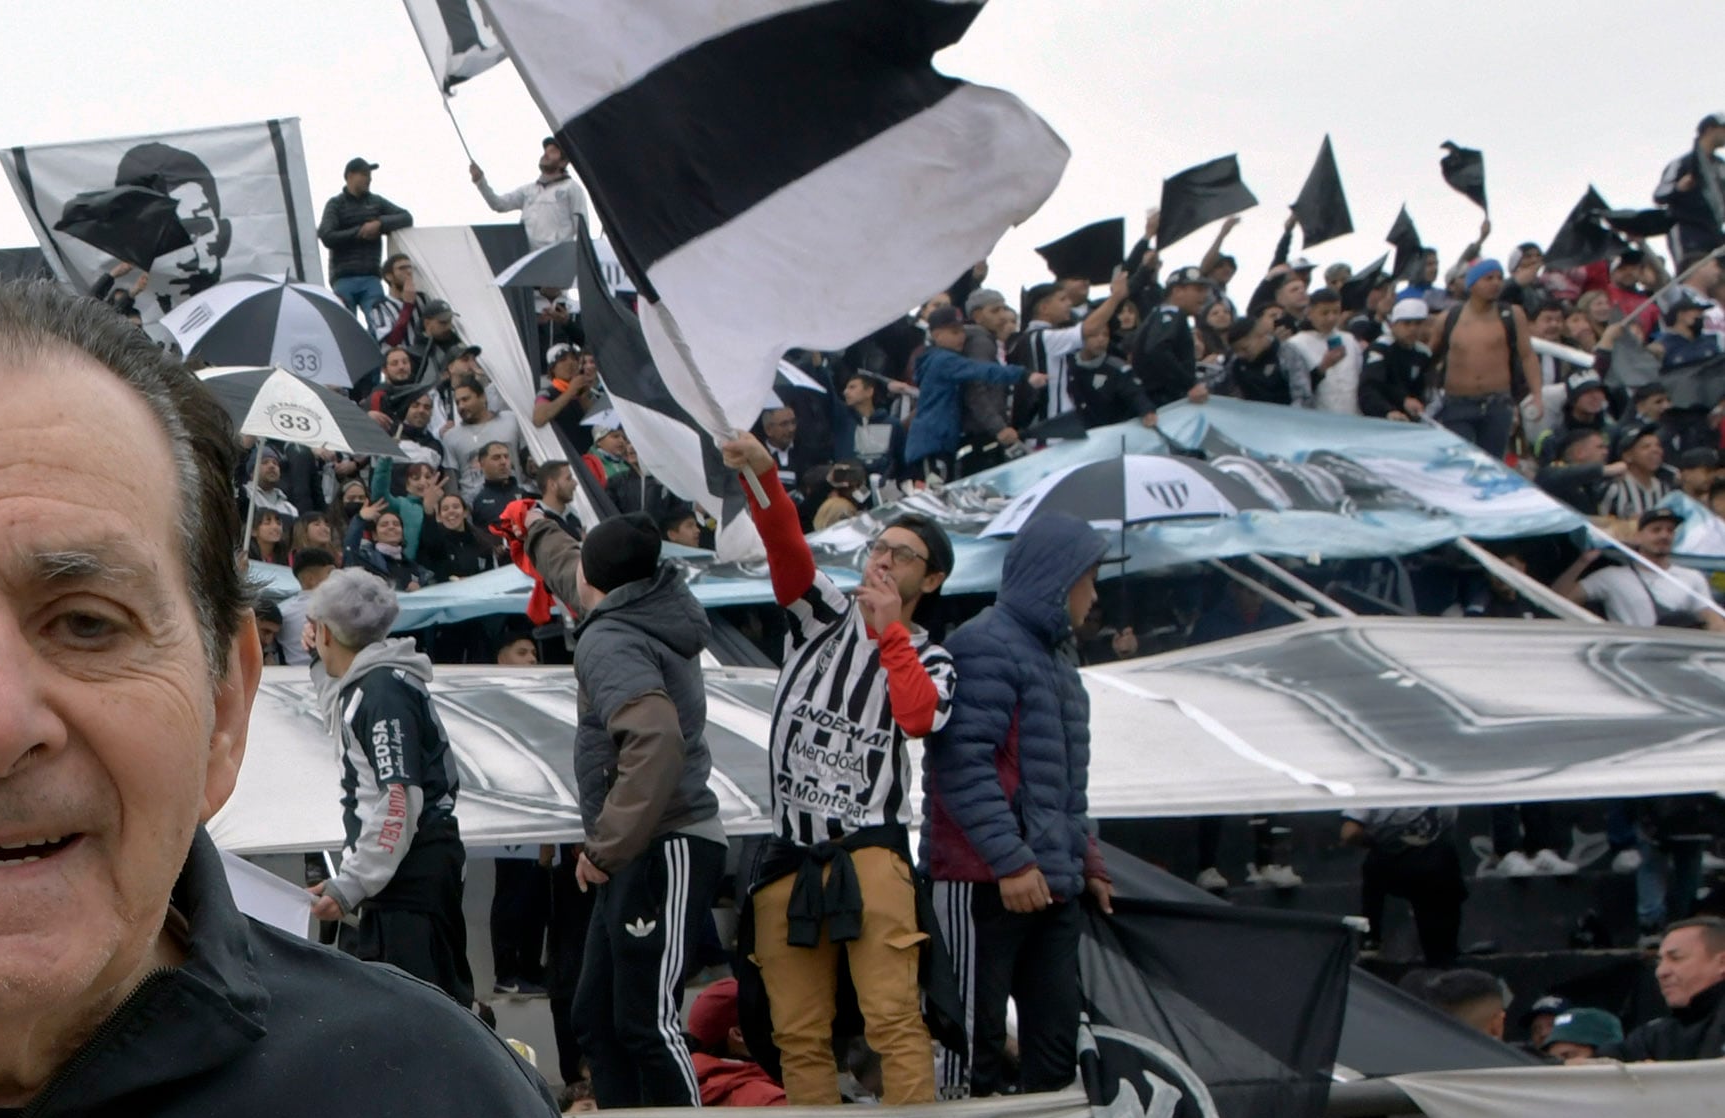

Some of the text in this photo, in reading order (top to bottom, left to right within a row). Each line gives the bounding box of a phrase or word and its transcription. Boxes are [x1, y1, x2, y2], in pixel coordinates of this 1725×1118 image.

[294, 354, 318, 372] 33
[279, 413, 311, 432] 33
[377, 819, 403, 855] SELF
